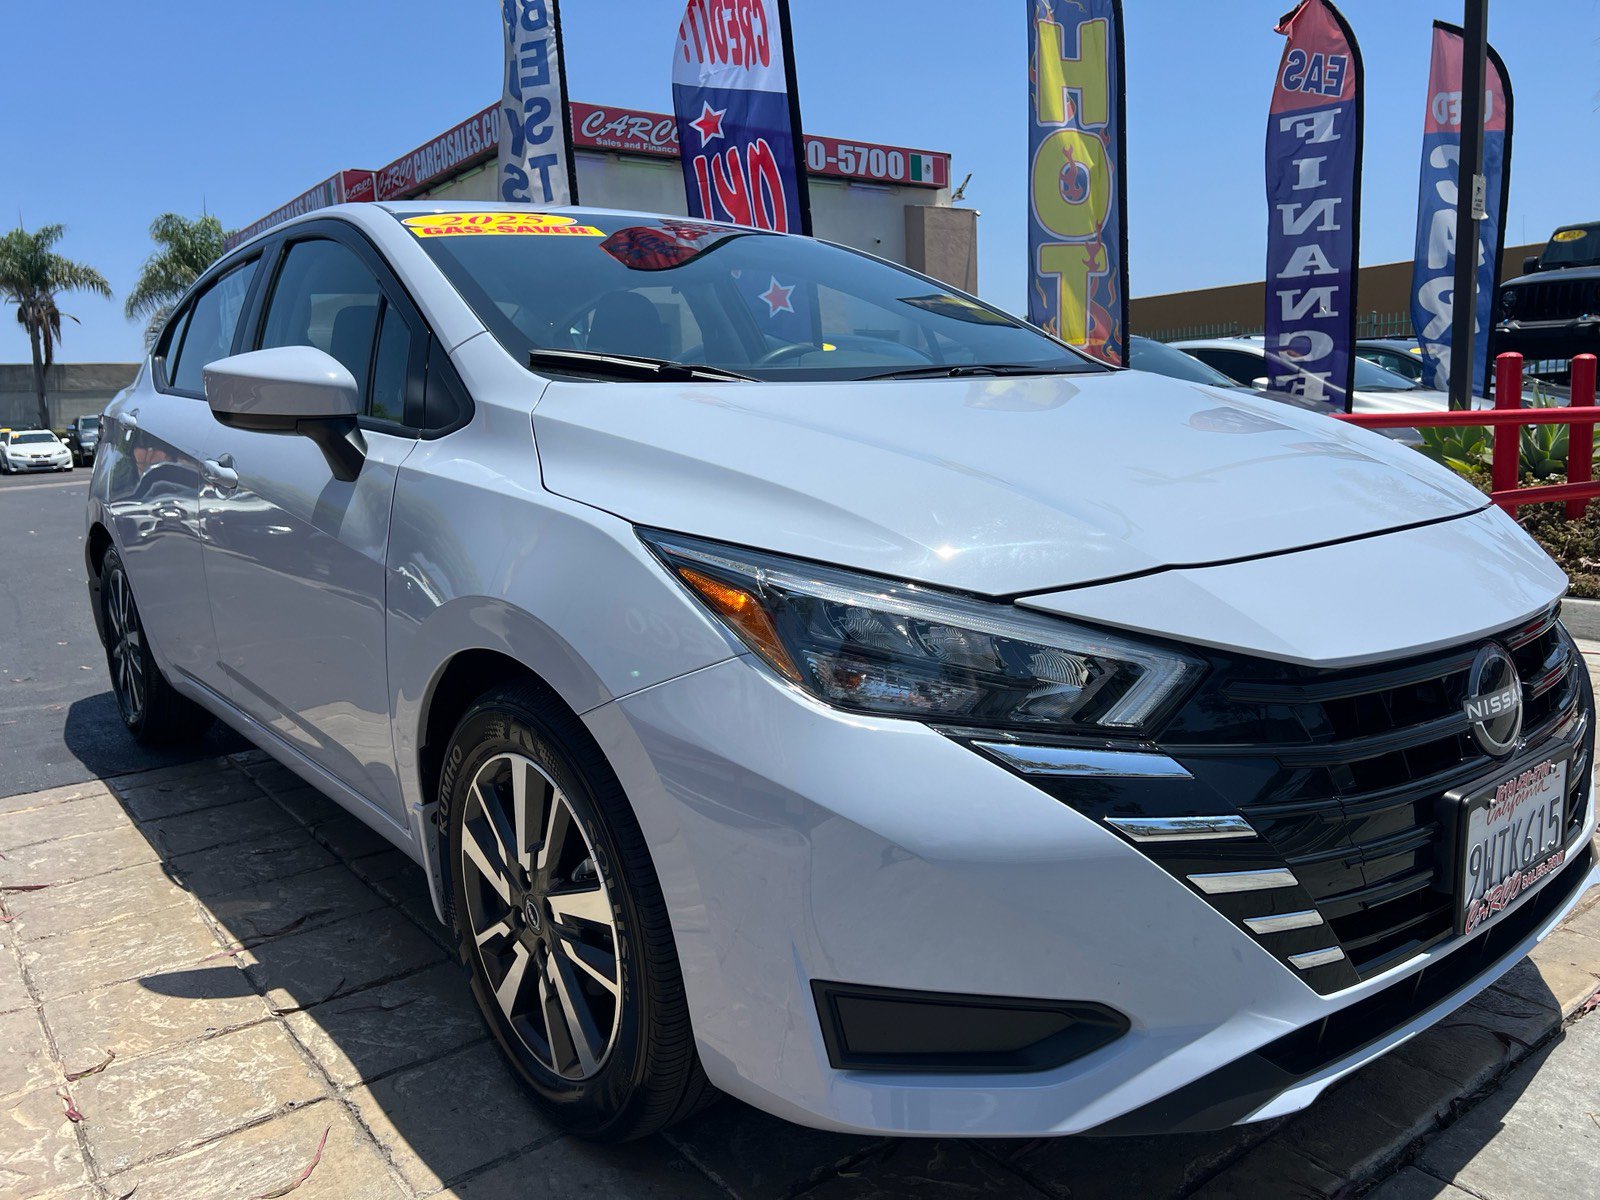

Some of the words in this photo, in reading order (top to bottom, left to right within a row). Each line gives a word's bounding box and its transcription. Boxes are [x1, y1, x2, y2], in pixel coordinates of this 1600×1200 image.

[413, 106, 501, 184] CARCOSALES.CO
[596, 138, 621, 147] Sales
[624, 141, 641, 149] and
[643, 143, 678, 154] Finance
[803, 140, 905, 180] 0-5700
[1030, 17, 1113, 349] HOT
[422, 225, 589, 236] GAS-SAVER
[441, 215, 544, 226] 2025
[1466, 683, 1522, 720] NISSA
[439, 744, 462, 837] KUMHO
[1486, 779, 1550, 826] California
